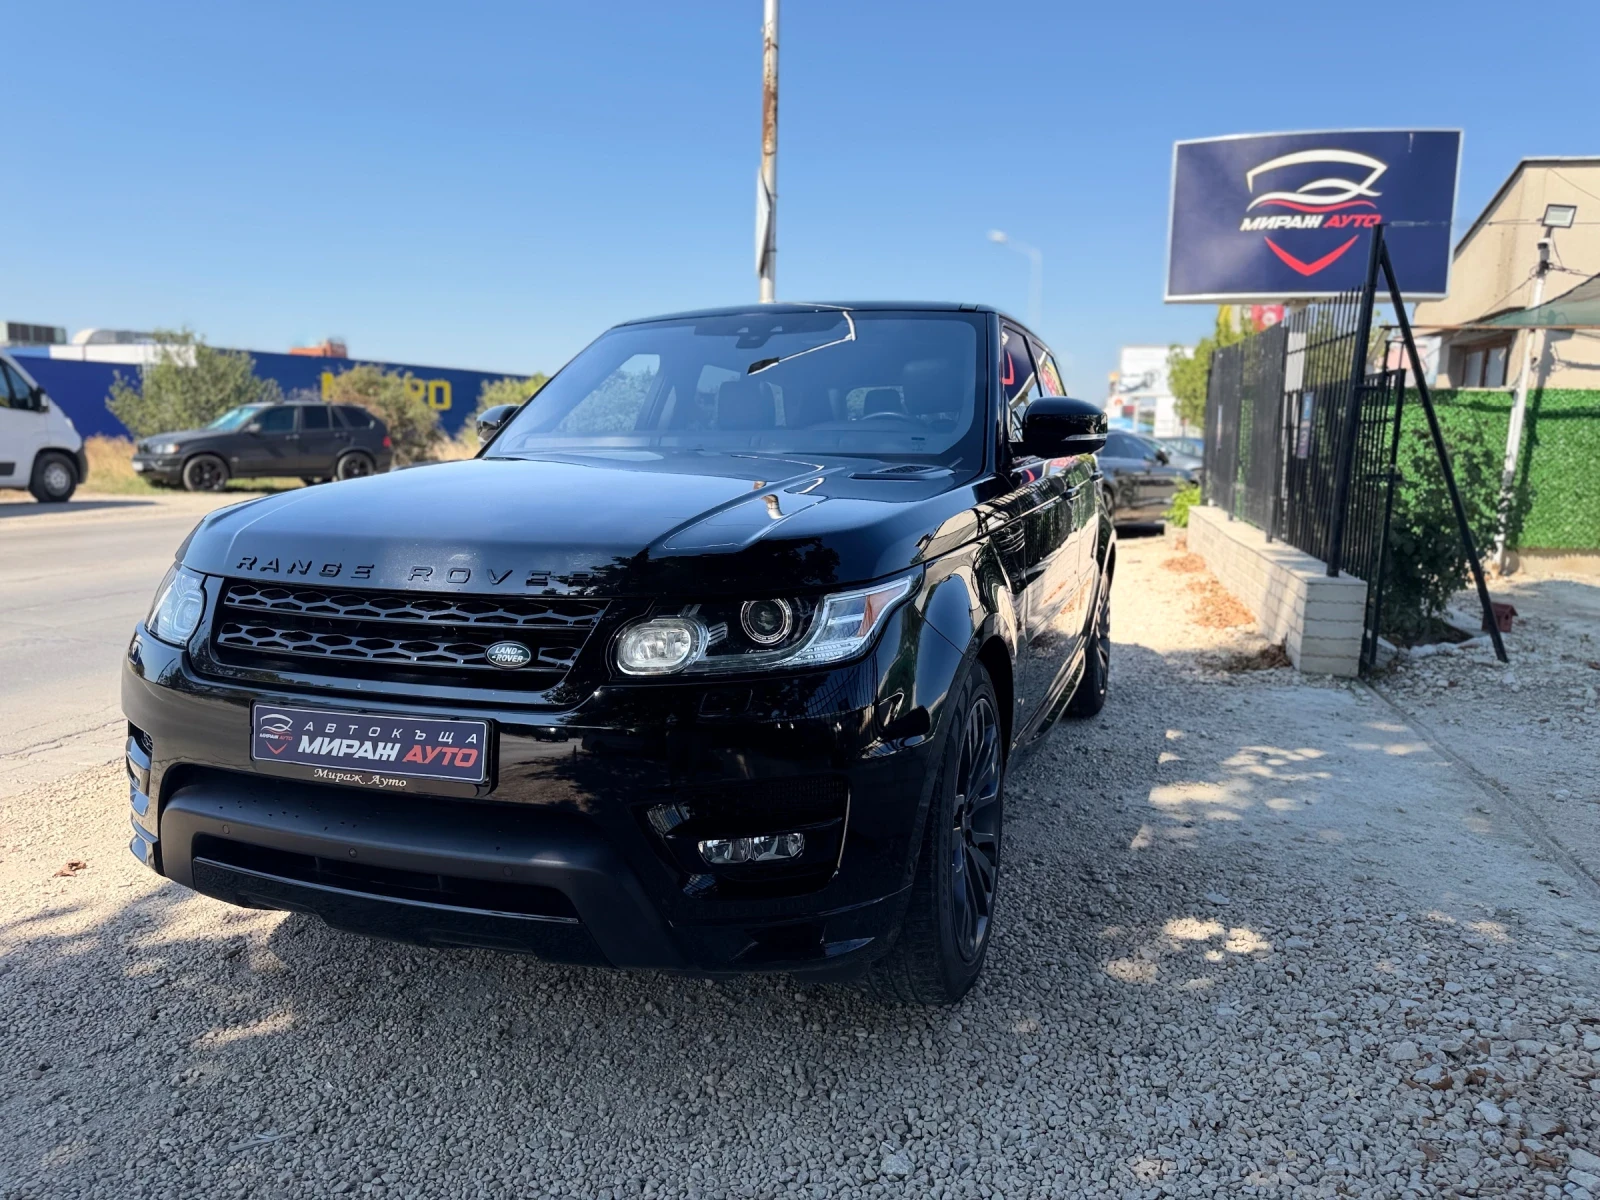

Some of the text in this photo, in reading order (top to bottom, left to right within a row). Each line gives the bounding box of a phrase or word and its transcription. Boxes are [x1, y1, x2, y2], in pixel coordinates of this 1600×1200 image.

[1240, 214, 1382, 231] МИРАЖ АУТО
[236, 556, 594, 588] RANGE ROVER
[304, 721, 477, 744] АВТОКЪЩА
[298, 735, 478, 767] МИРАЖ АУТО
[314, 768, 407, 788] Мираж Ауто
